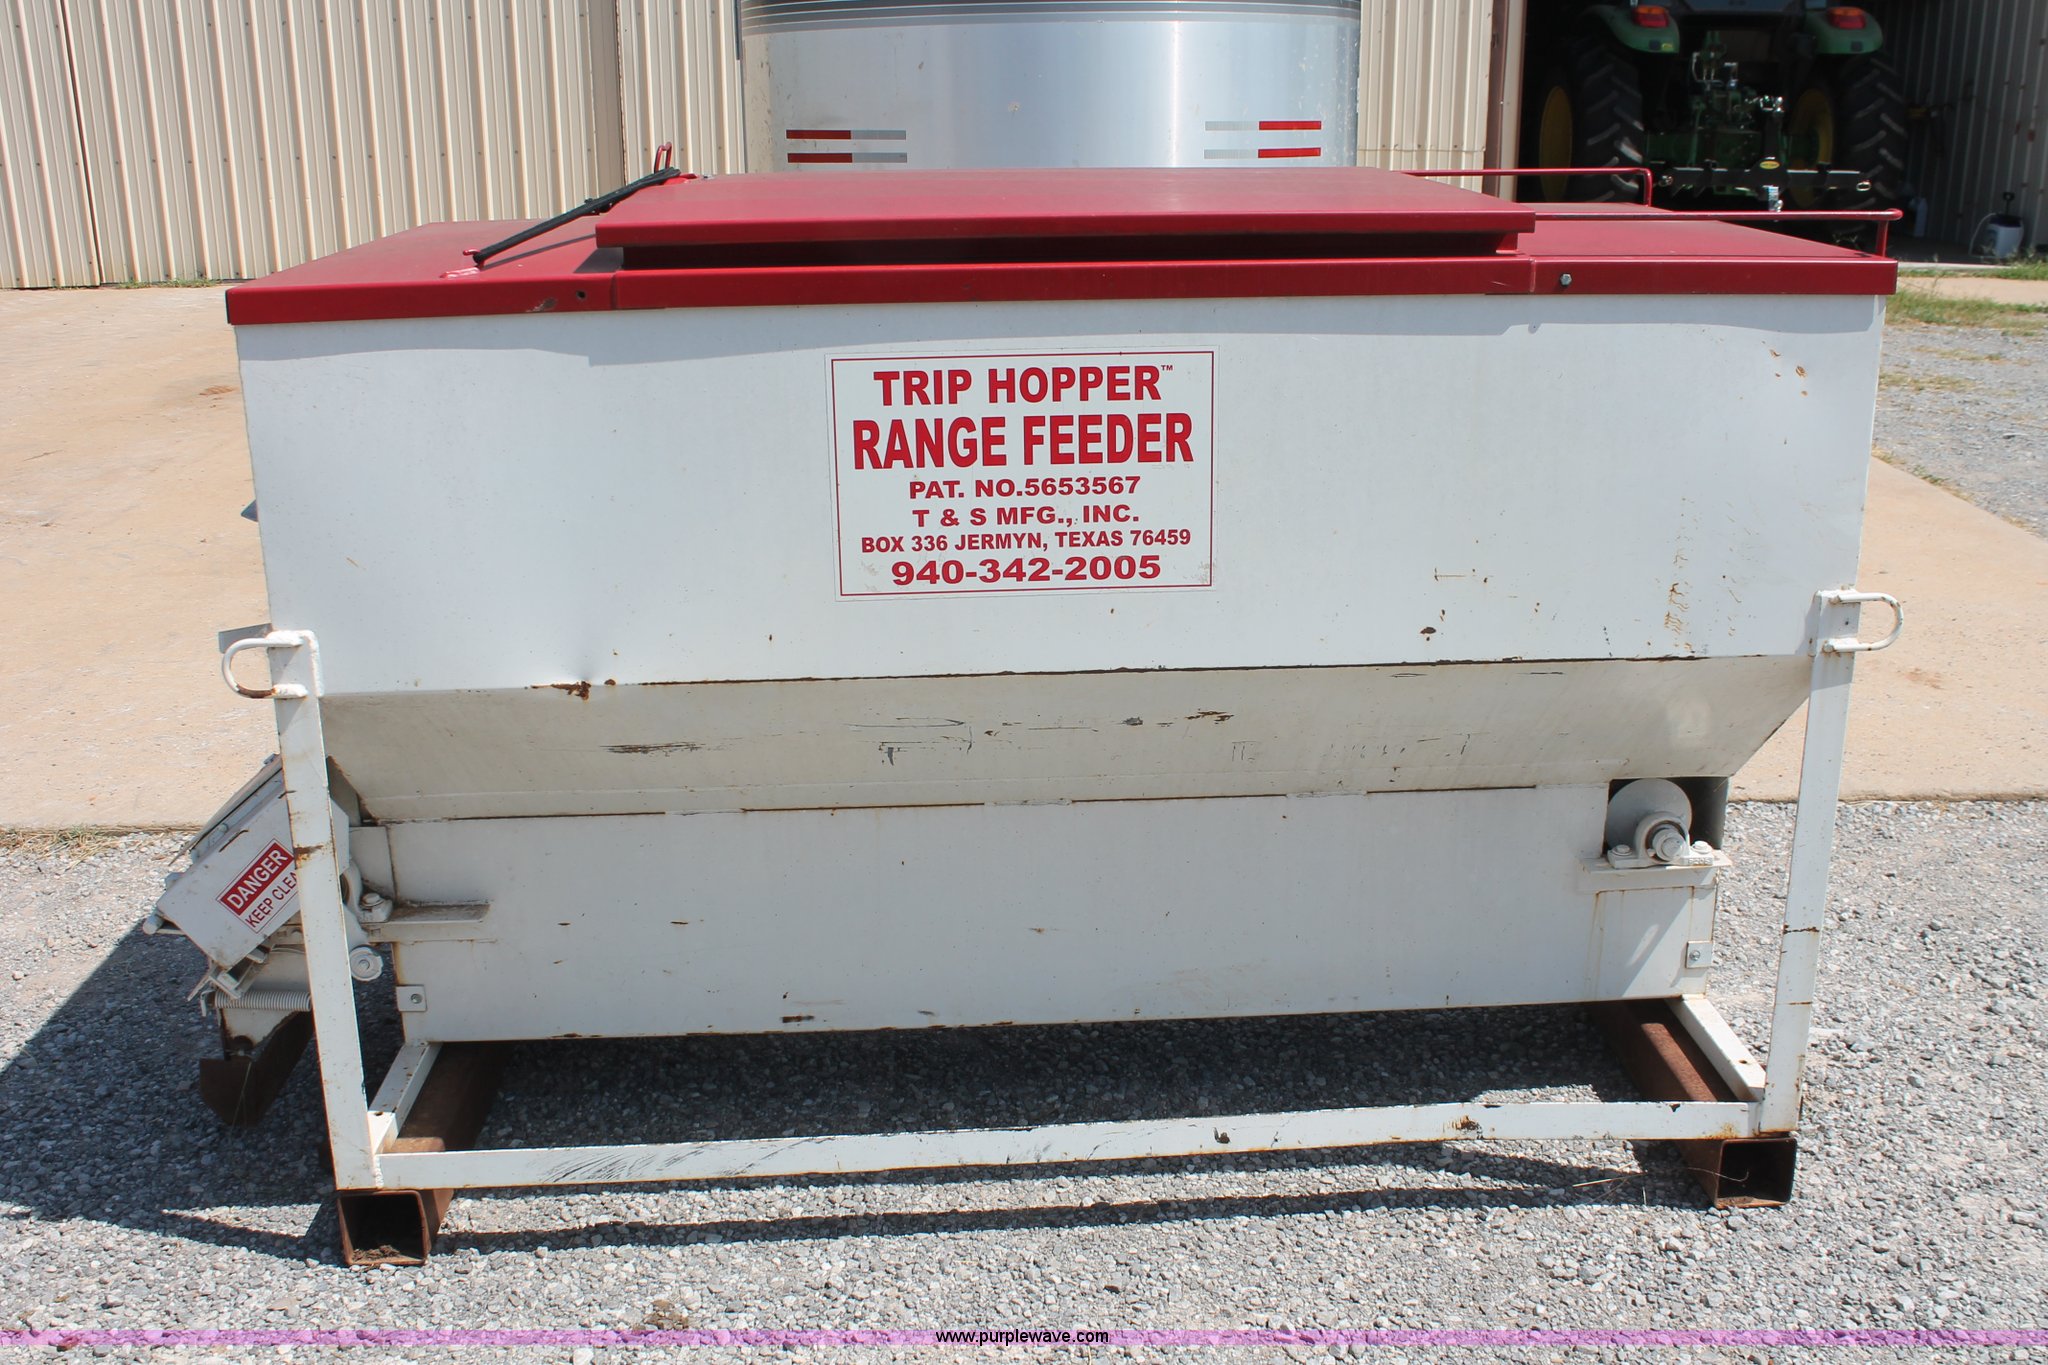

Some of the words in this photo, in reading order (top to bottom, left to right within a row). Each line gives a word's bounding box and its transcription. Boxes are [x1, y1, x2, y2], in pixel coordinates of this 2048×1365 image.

[874, 369, 973, 407] TRIP
[853, 416, 1008, 471] RANGE
[1023, 412, 1195, 466] FEEDER
[909, 479, 965, 500] PAT.
[912, 508, 931, 528] T
[940, 508, 961, 527] &
[970, 507, 988, 527] S
[996, 505, 1074, 528] MFG.,
[1083, 504, 1141, 523] INC.
[861, 535, 905, 554] BOX
[911, 534, 949, 553] 336
[954, 531, 1049, 553] JERMYN,
[1055, 530, 1124, 549] TEXAS
[1130, 528, 1192, 547] 76459
[891, 554, 1162, 586] 940-342-2005
[226, 849, 289, 910] DANGER
[244, 897, 274, 928] KEEP
[271, 871, 297, 901] CLEA
